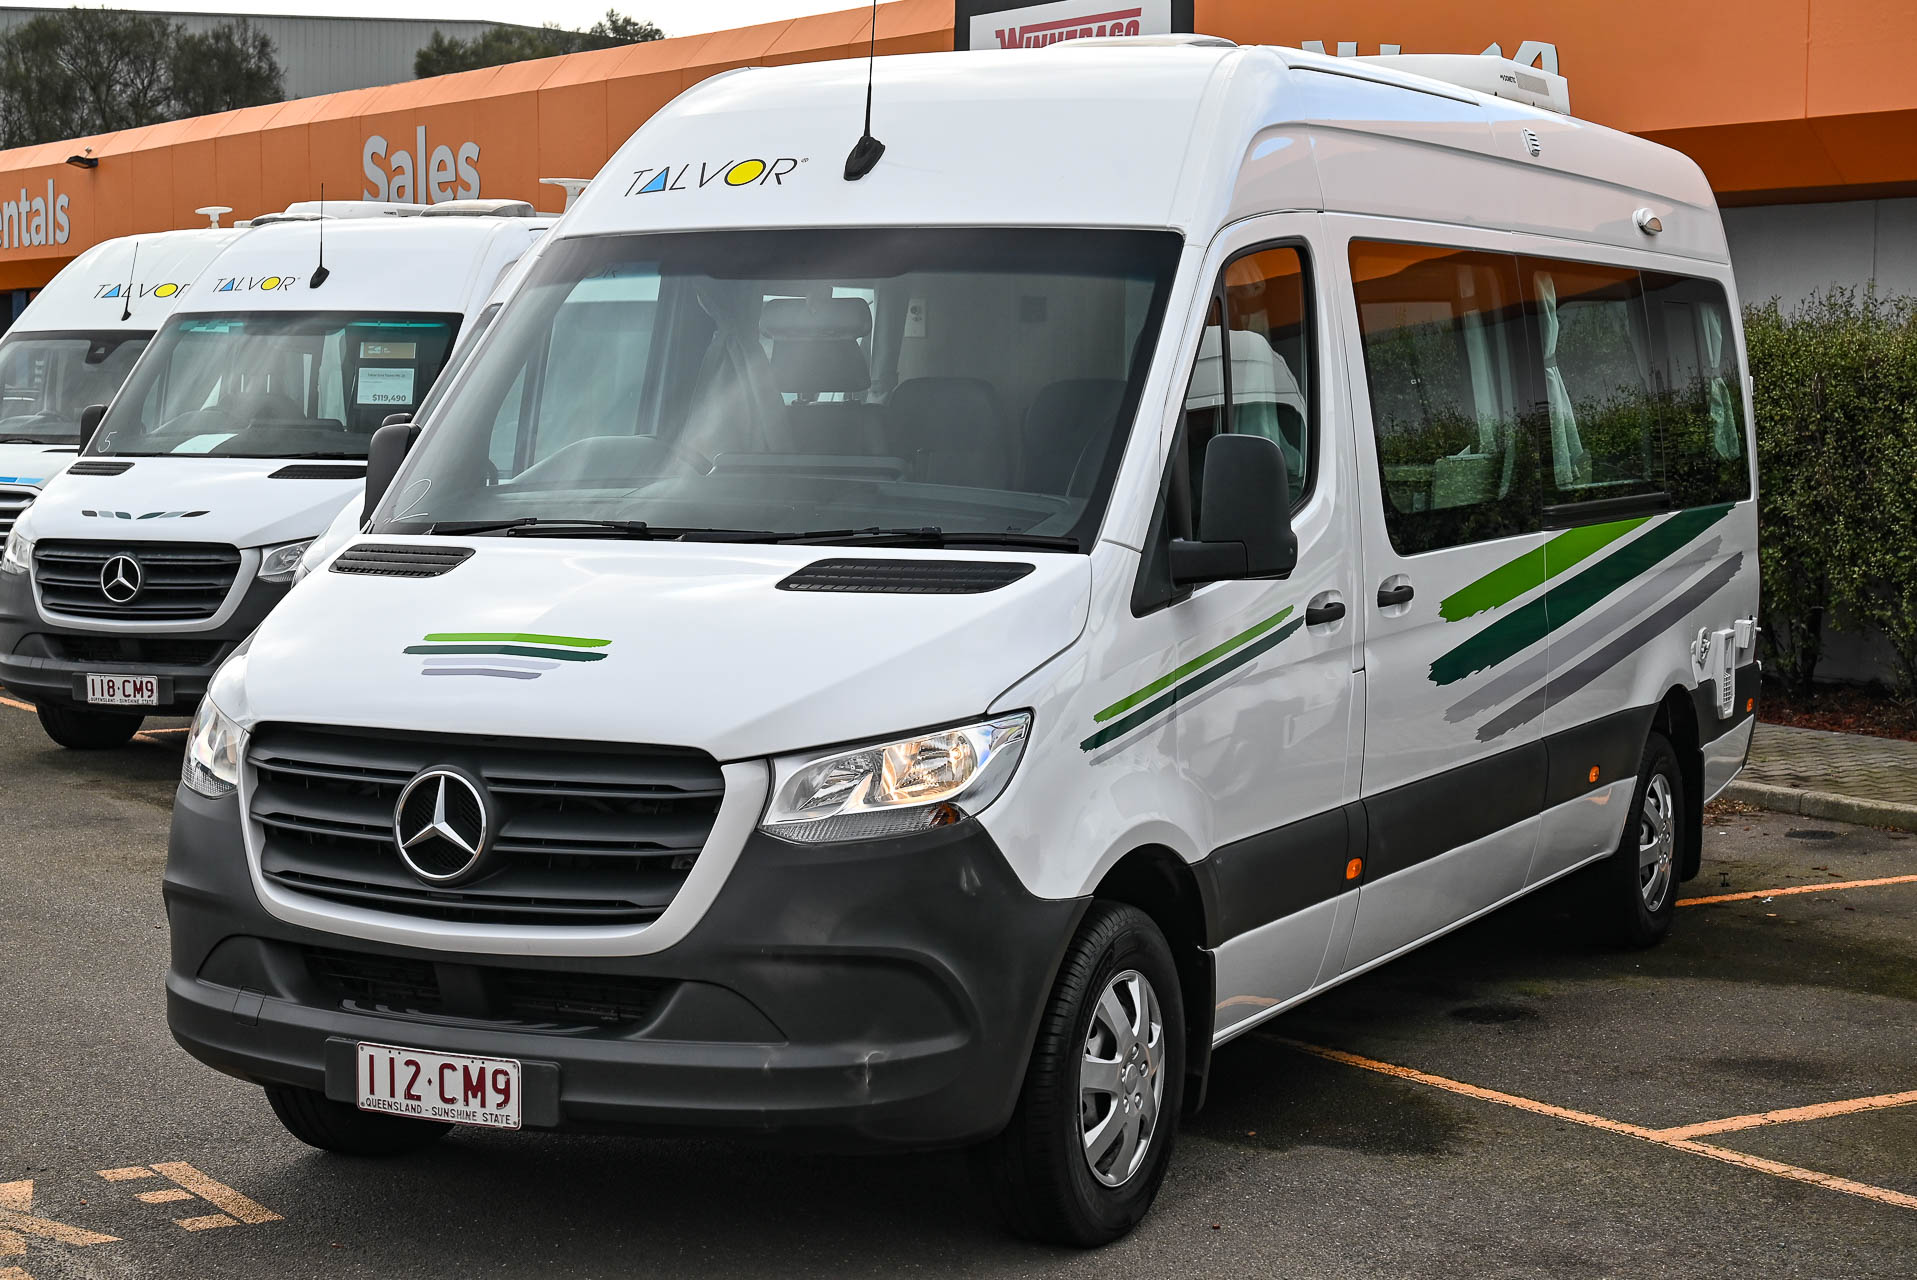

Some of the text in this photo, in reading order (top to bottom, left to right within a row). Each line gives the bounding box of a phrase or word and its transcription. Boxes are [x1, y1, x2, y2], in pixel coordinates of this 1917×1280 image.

[363, 125, 481, 203] Sales
[0, 178, 70, 249] ntals
[372, 394, 407, 403] $119,490
[365, 1097, 422, 1114] QUEENSLAND
[431, 1106, 478, 1122] SUNSHINE
[482, 1112, 511, 1125] STATE
